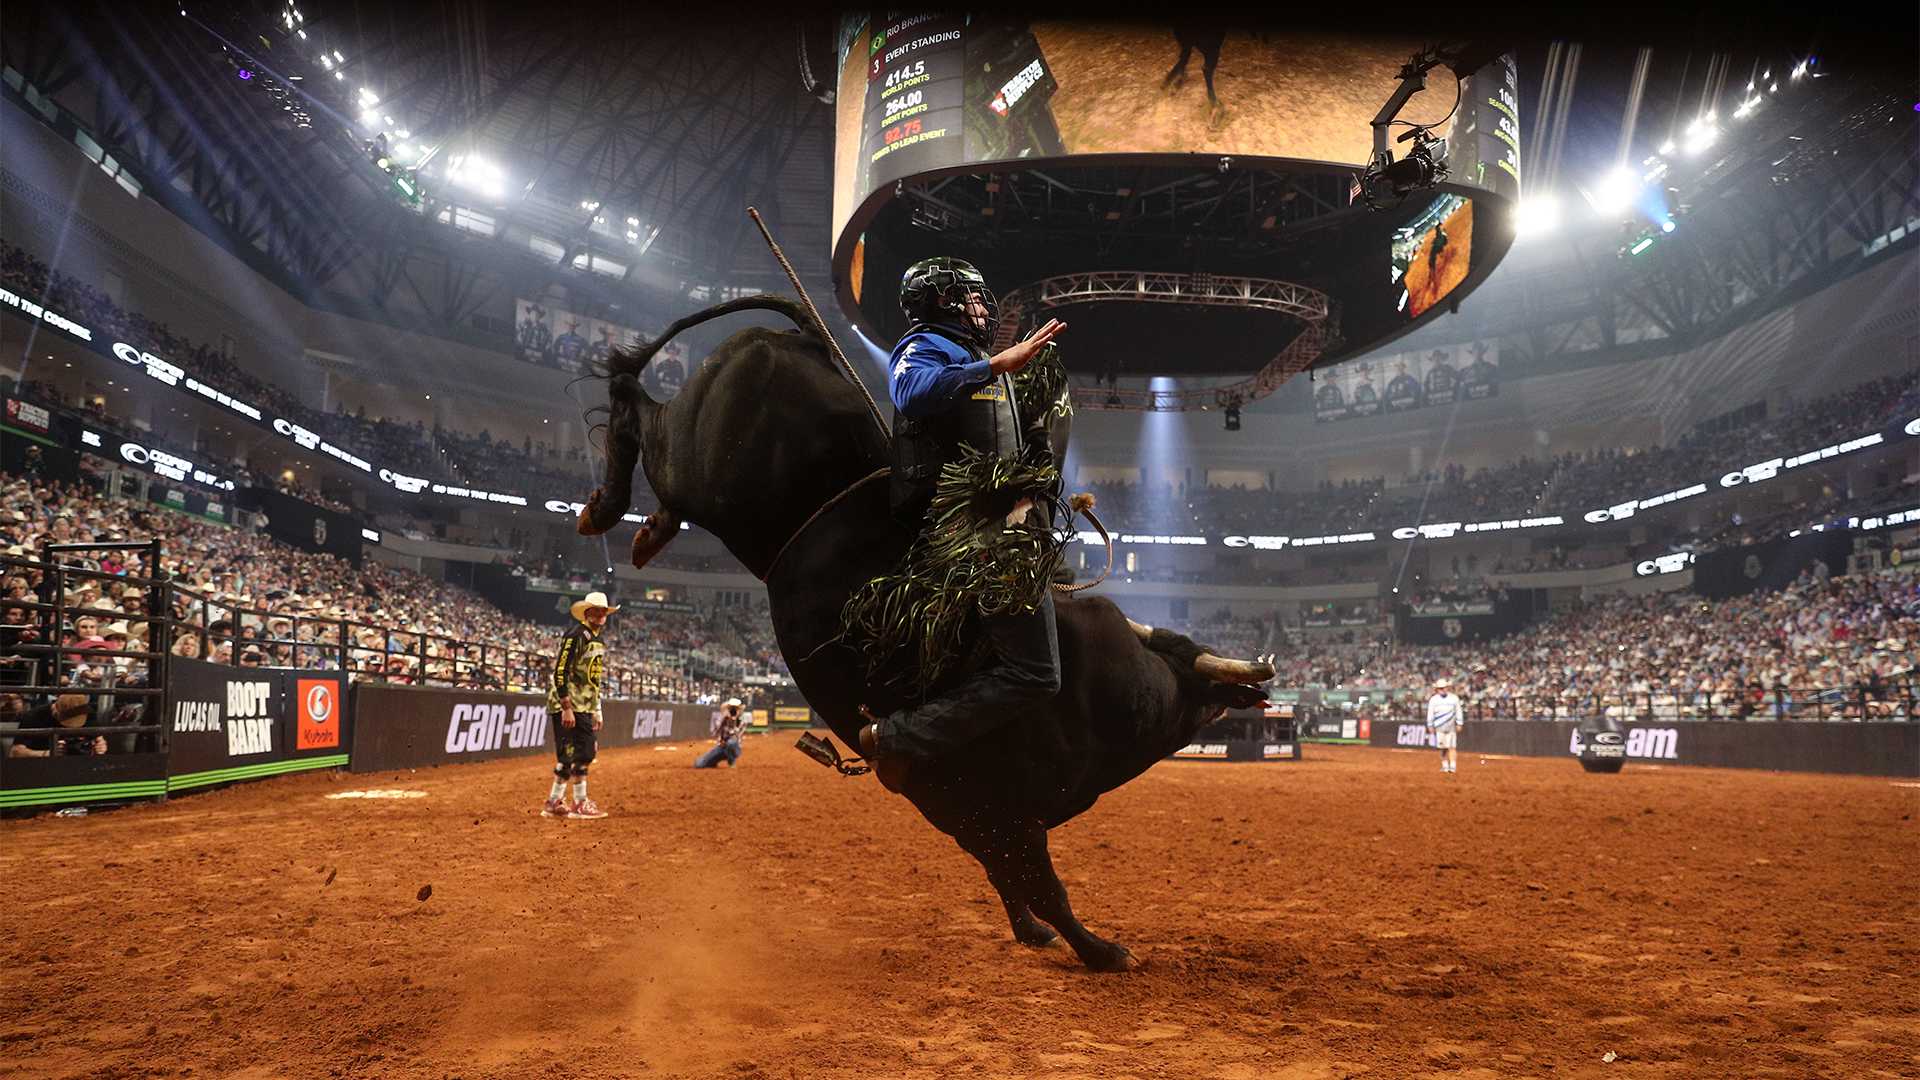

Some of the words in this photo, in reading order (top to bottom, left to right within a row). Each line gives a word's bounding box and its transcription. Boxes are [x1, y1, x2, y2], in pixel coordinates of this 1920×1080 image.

[884, 43, 910, 63] EVENT
[911, 30, 961, 50] STANDING
[885, 60, 925, 87] 414.5
[903, 73, 930, 88] POINTS
[885, 90, 922, 117] 264.00
[149, 449, 193, 472] COOPER
[227, 681, 270, 717] BOOT
[174, 701, 207, 732] LUCAS
[207, 702, 221, 733] OIL
[227, 718, 272, 756] BARN
